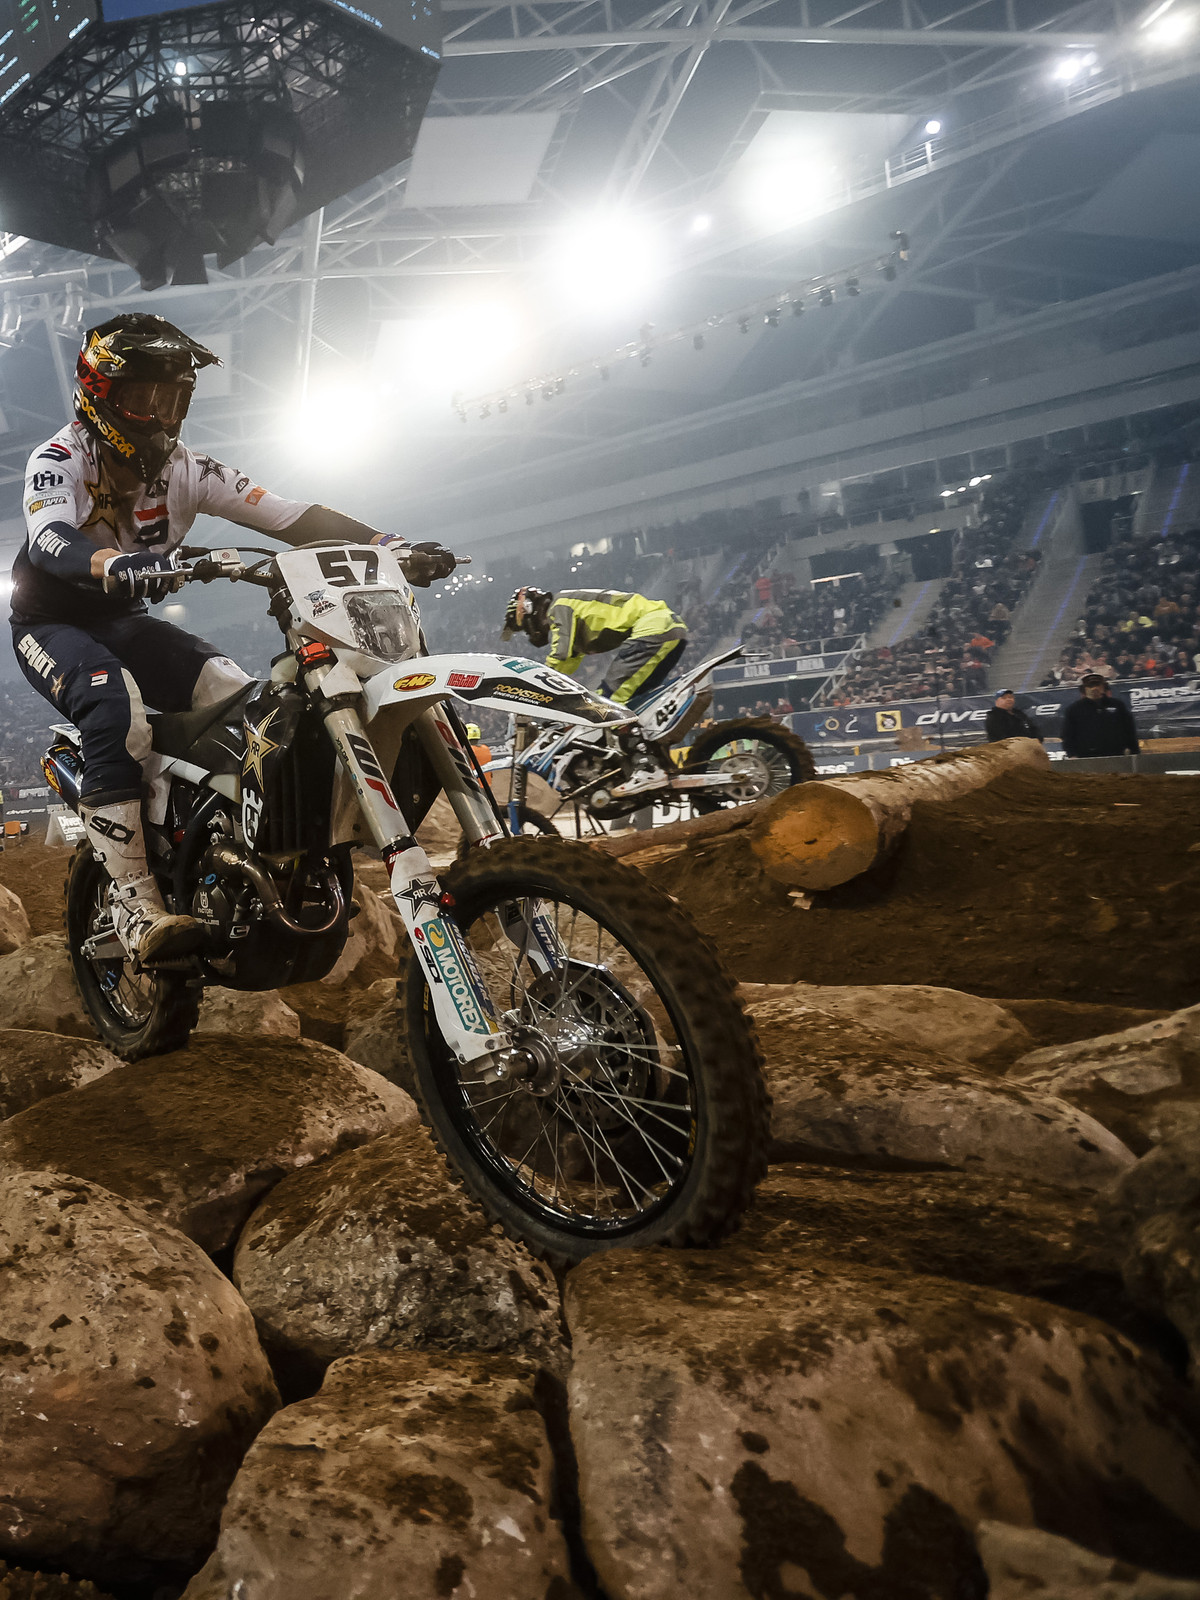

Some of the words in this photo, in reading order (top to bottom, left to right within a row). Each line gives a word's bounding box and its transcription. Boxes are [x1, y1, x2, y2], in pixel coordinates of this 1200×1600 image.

[36, 528, 72, 558] SHOT
[315, 549, 380, 588] 57
[17, 633, 57, 679] SHOT
[394, 675, 435, 689] FMF
[492, 684, 554, 704] ROCKSTAR
[435, 947, 487, 1034] MOTOREX
